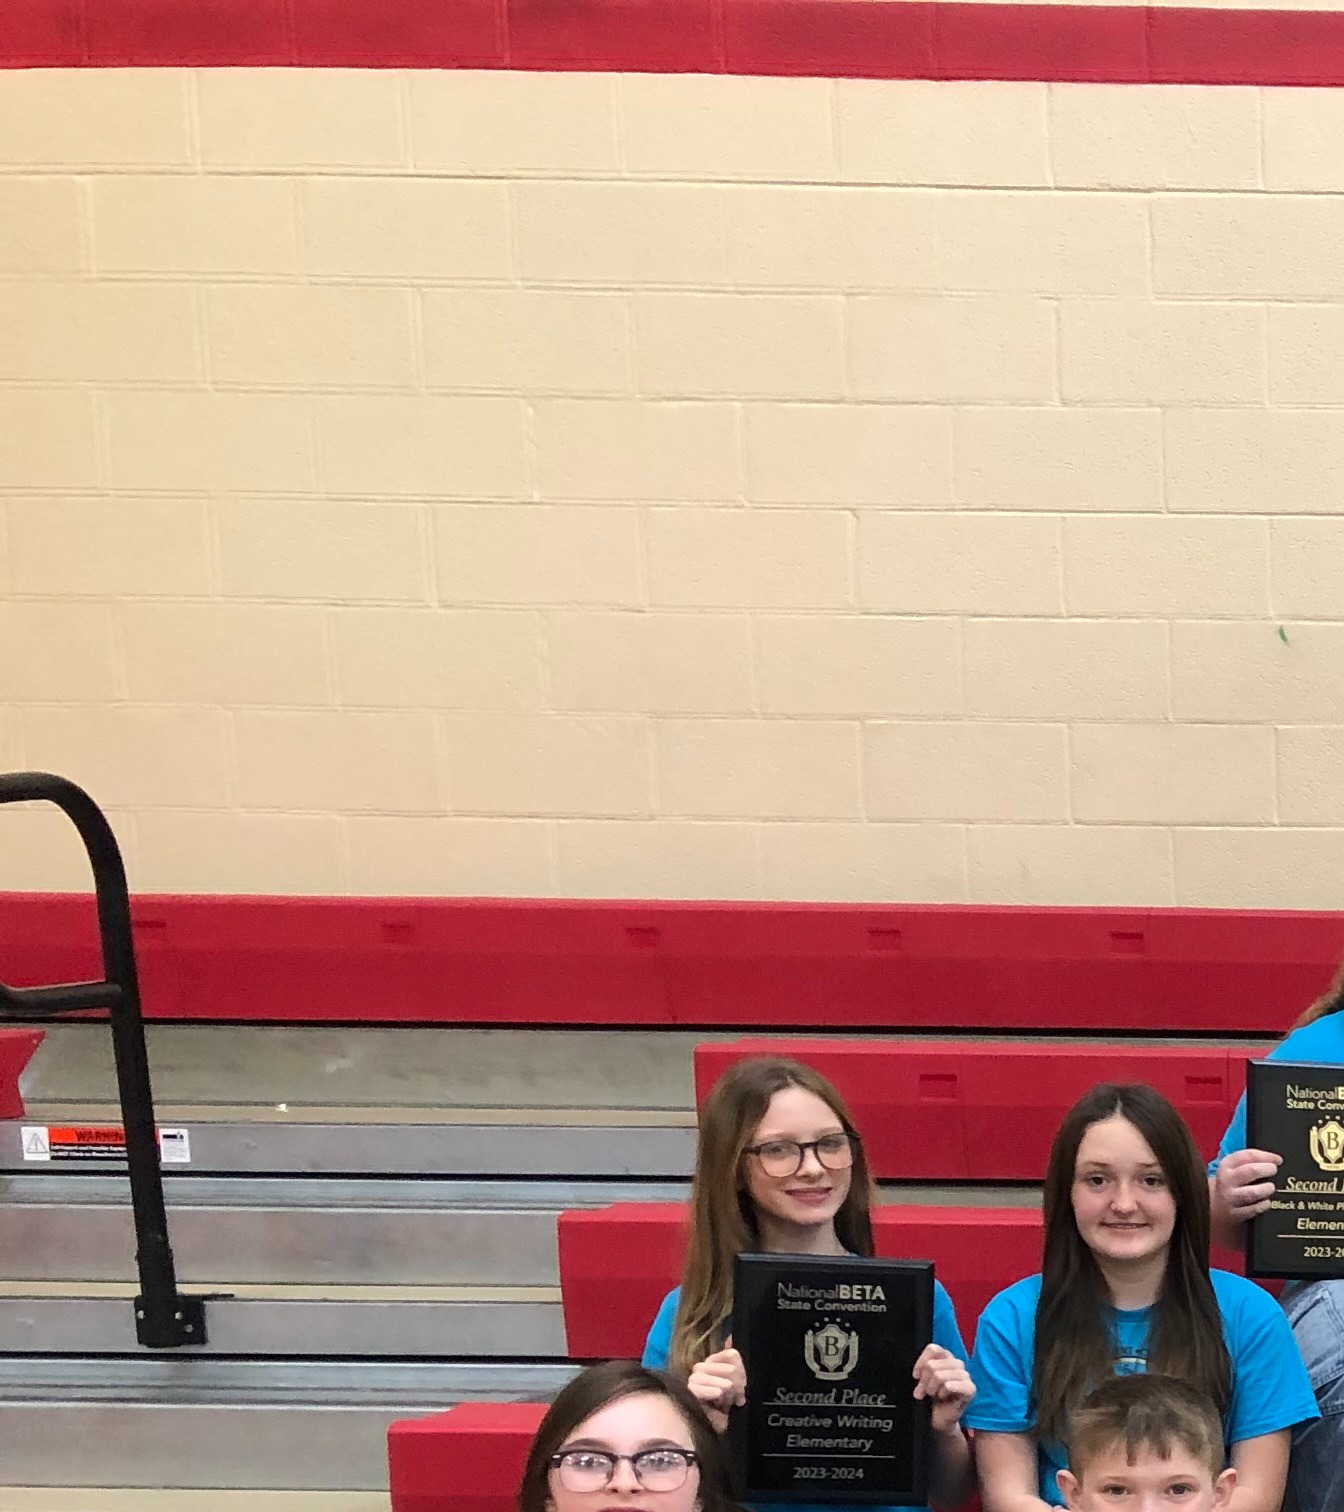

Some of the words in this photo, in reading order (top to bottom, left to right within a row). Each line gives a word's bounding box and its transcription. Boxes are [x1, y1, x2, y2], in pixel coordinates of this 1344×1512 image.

[1286, 1099, 1314, 1110] State
[1286, 1177, 1338, 1191] Second
[1271, 1201, 1295, 1211] Black
[1298, 1202, 1305, 1210] &
[1307, 1202, 1333, 1211] White
[777, 1283, 885, 1300] NationalBETA
[777, 1300, 811, 1310] State
[815, 1301, 887, 1313] Convention
[775, 1388, 837, 1405] Second
[842, 1389, 886, 1405] Place
[767, 1414, 832, 1428] Creative
[837, 1415, 893, 1432] Writing
[787, 1434, 873, 1451] Elementary
[794, 1467, 864, 1479] 2023-2024
